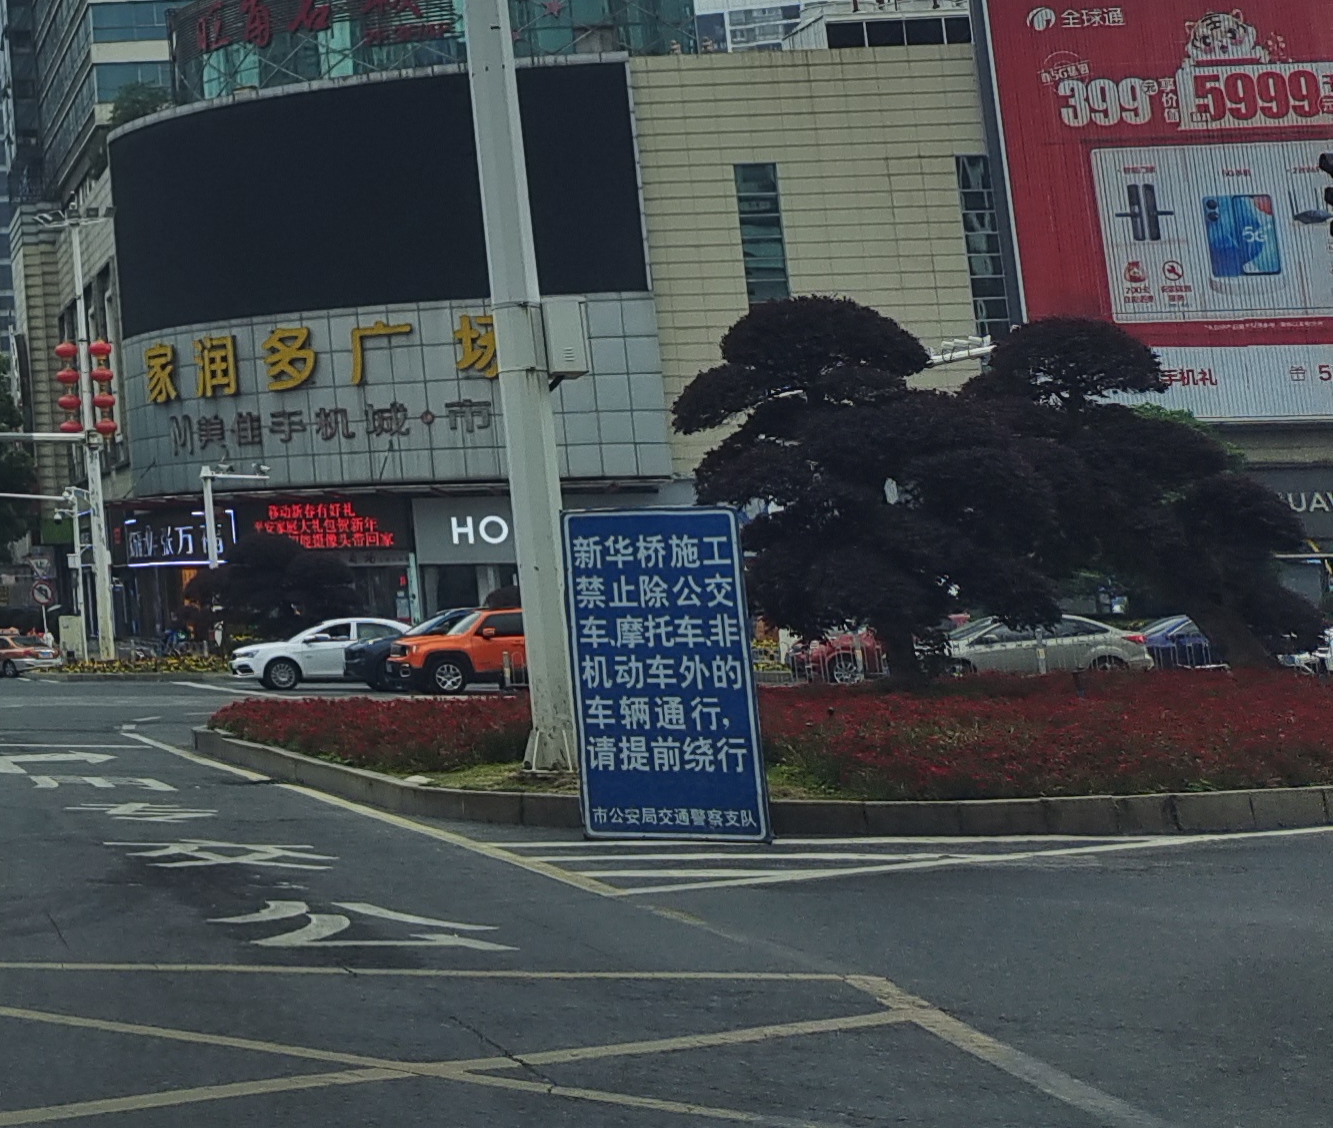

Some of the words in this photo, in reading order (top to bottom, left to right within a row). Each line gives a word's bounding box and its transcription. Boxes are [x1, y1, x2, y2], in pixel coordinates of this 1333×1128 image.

[1060, 7, 1126, 28] 全球通
[1058, 77, 1152, 128] 399
[1193, 70, 1321, 121] 5999
[144, 314, 499, 404] 家润多广场
[1277, 491, 1333, 512] UA
[573, 535, 732, 569] 新华桥施工
[576, 573, 734, 608] 禁止除公交
[579, 614, 740, 648] 车、摩托车、非
[581, 655, 743, 690] 机动车外的
[587, 736, 749, 773] 请提前绕行
[591, 806, 758, 829] 市公安局交通警察支队
